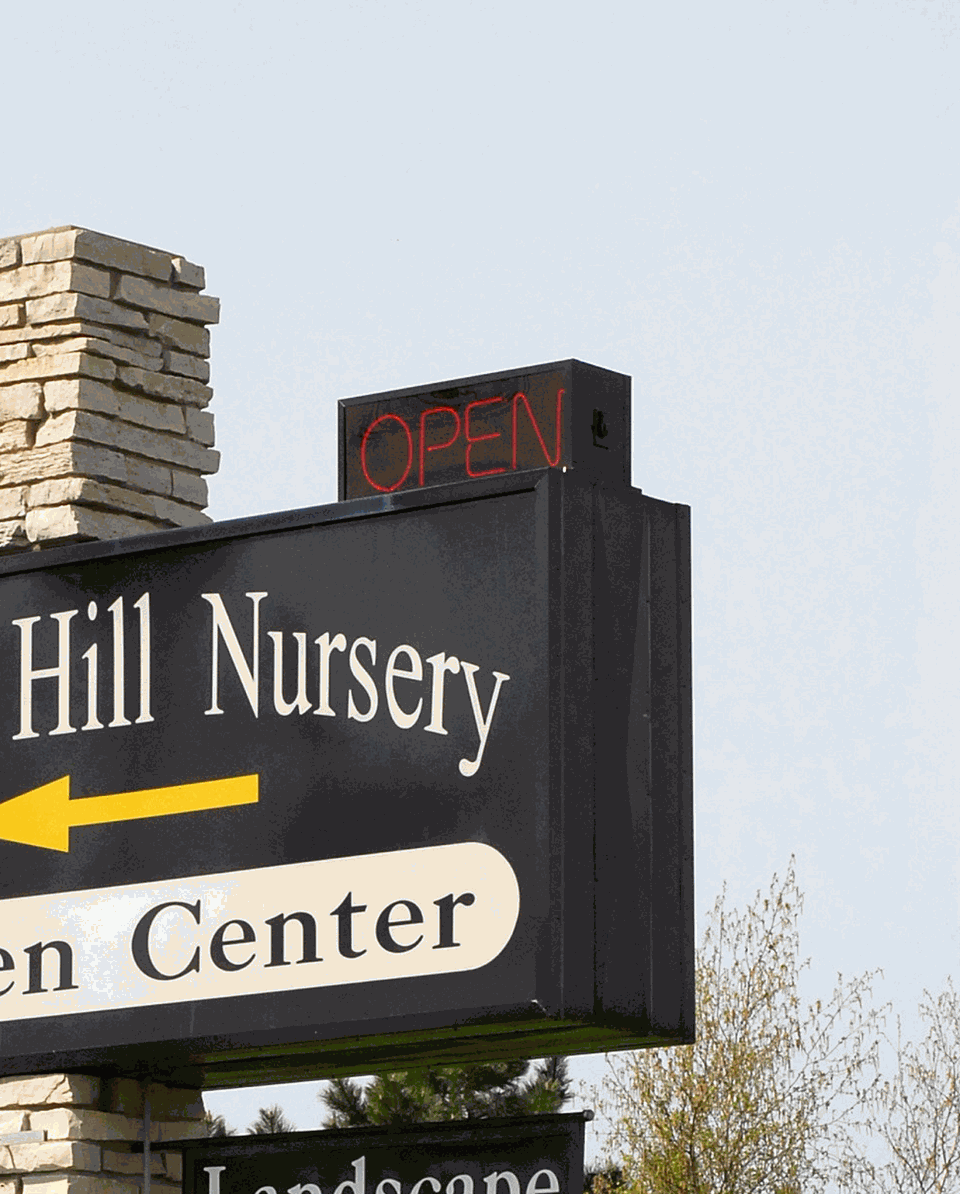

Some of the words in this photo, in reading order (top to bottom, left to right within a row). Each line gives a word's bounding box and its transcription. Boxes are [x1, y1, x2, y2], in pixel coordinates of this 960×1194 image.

[360, 388, 565, 492] OPEN
[12, 592, 154, 741] Hill
[202, 591, 510, 777] Nursery
[131, 891, 476, 982] Center
